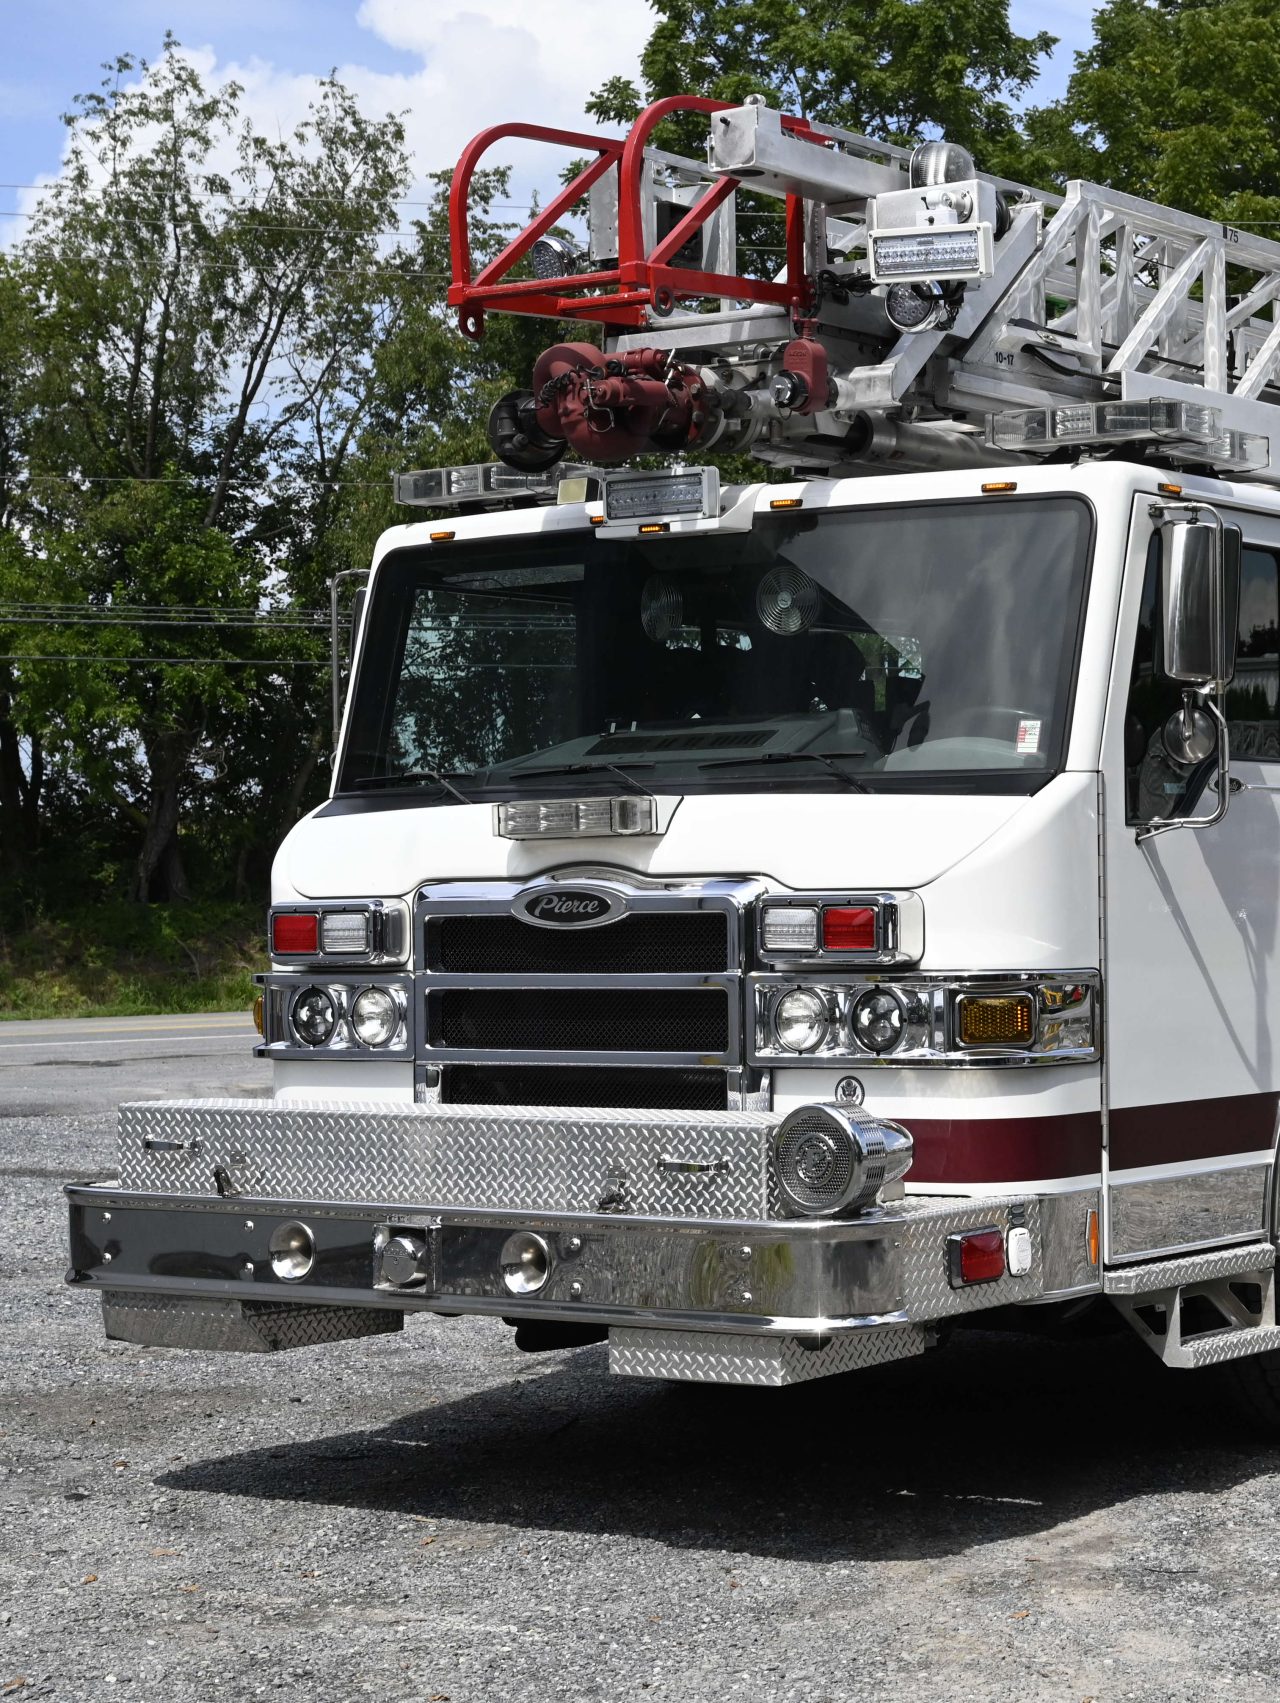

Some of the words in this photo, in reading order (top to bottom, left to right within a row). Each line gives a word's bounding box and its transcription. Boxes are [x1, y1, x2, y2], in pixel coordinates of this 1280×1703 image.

[1229, 228, 1239, 243] 75
[995, 351, 1014, 366] 10-17
[534, 894, 600, 917] Pierce
